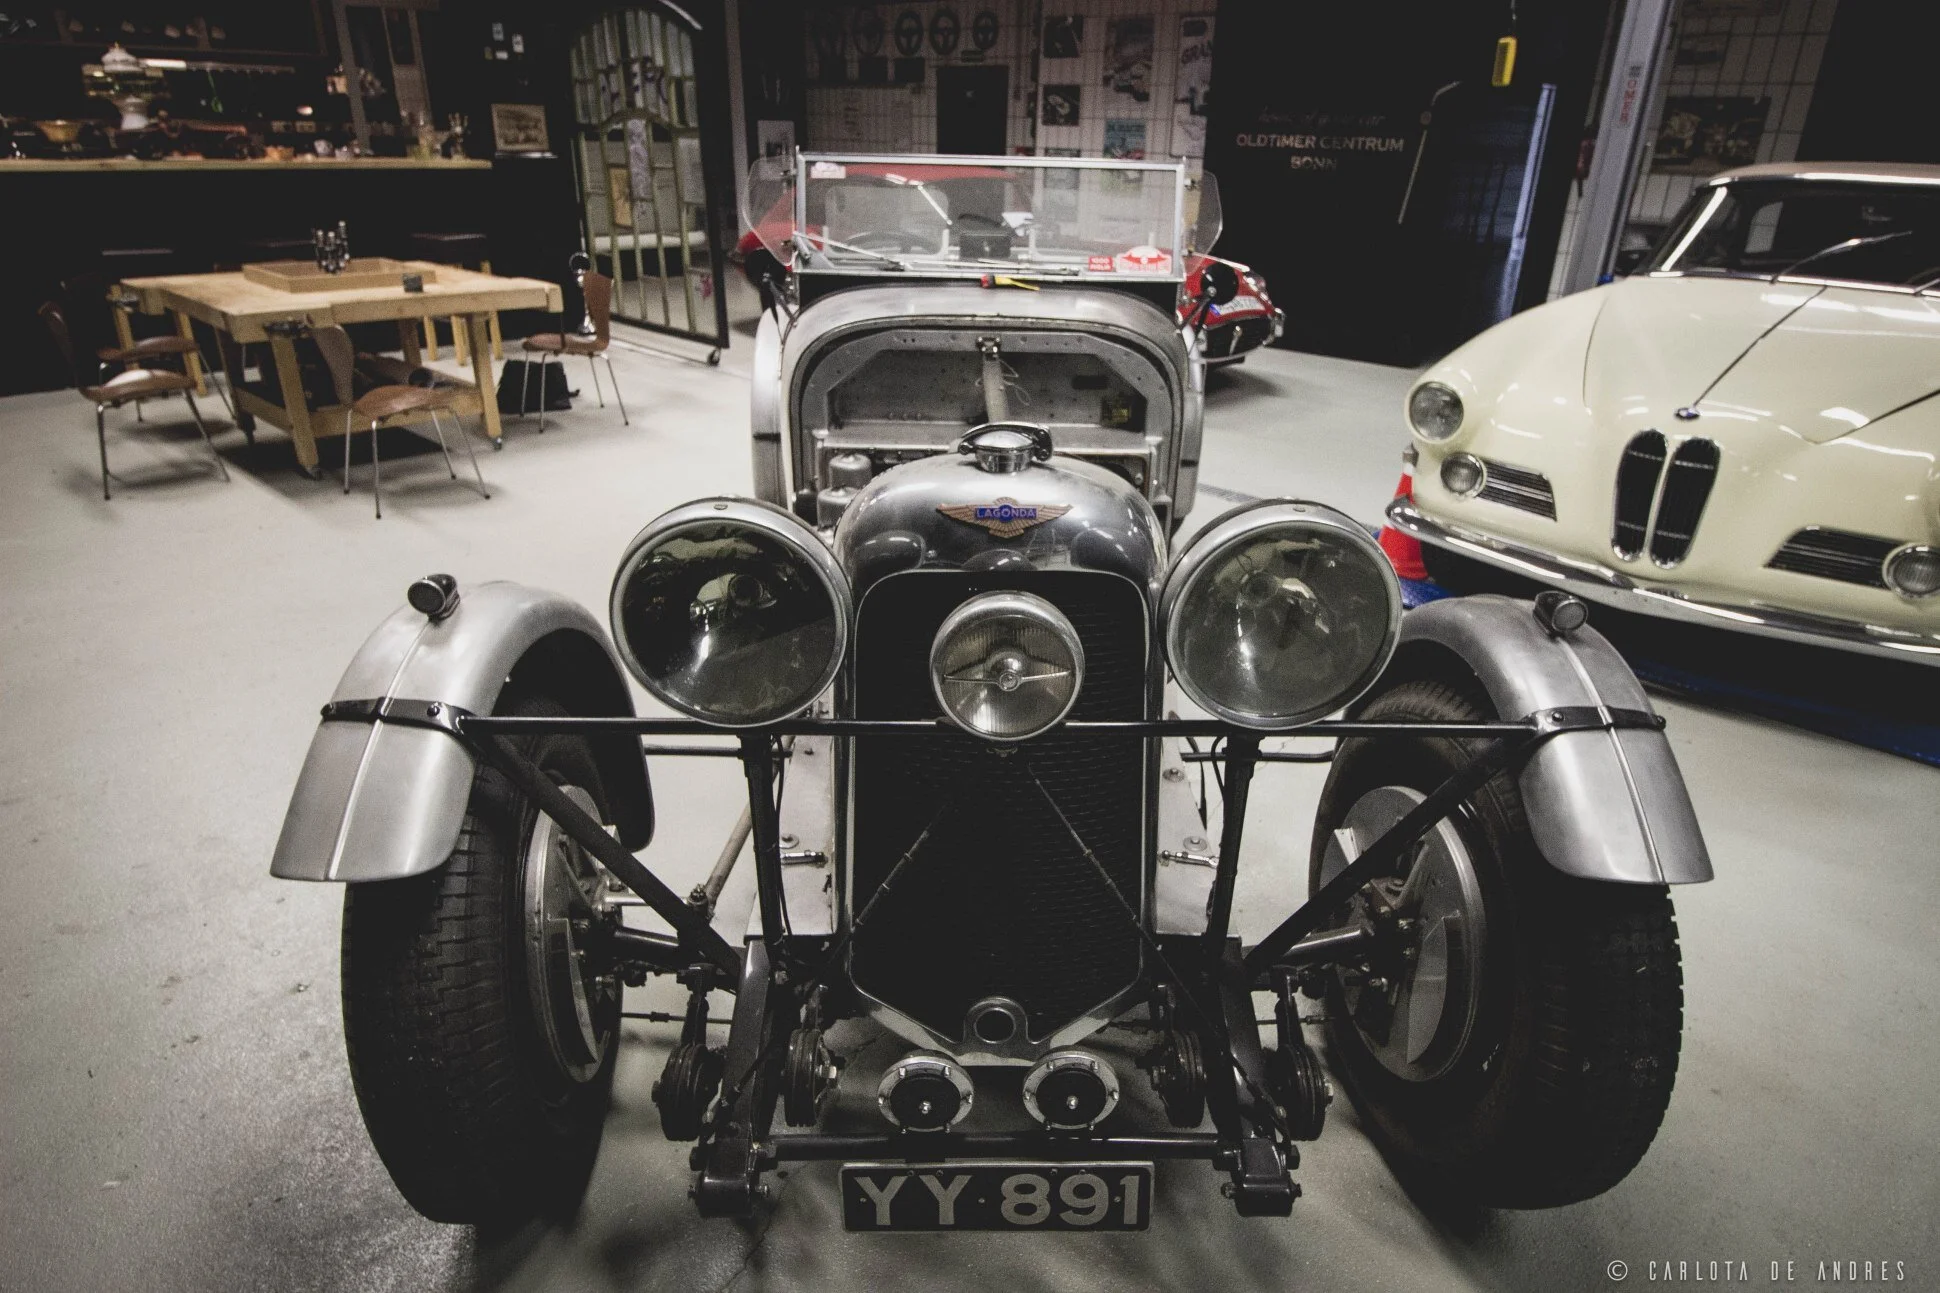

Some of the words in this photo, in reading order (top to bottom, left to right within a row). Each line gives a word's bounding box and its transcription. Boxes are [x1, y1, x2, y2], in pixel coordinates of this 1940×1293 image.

[1236, 133, 1317, 149] OLDTIMER
[1319, 135, 1405, 152] CENTRUM
[1290, 155, 1338, 171] BONN
[976, 508, 1035, 518] LAGONDA
[854, 1174, 973, 1226] YY
[1000, 1173, 1141, 1226] 891
